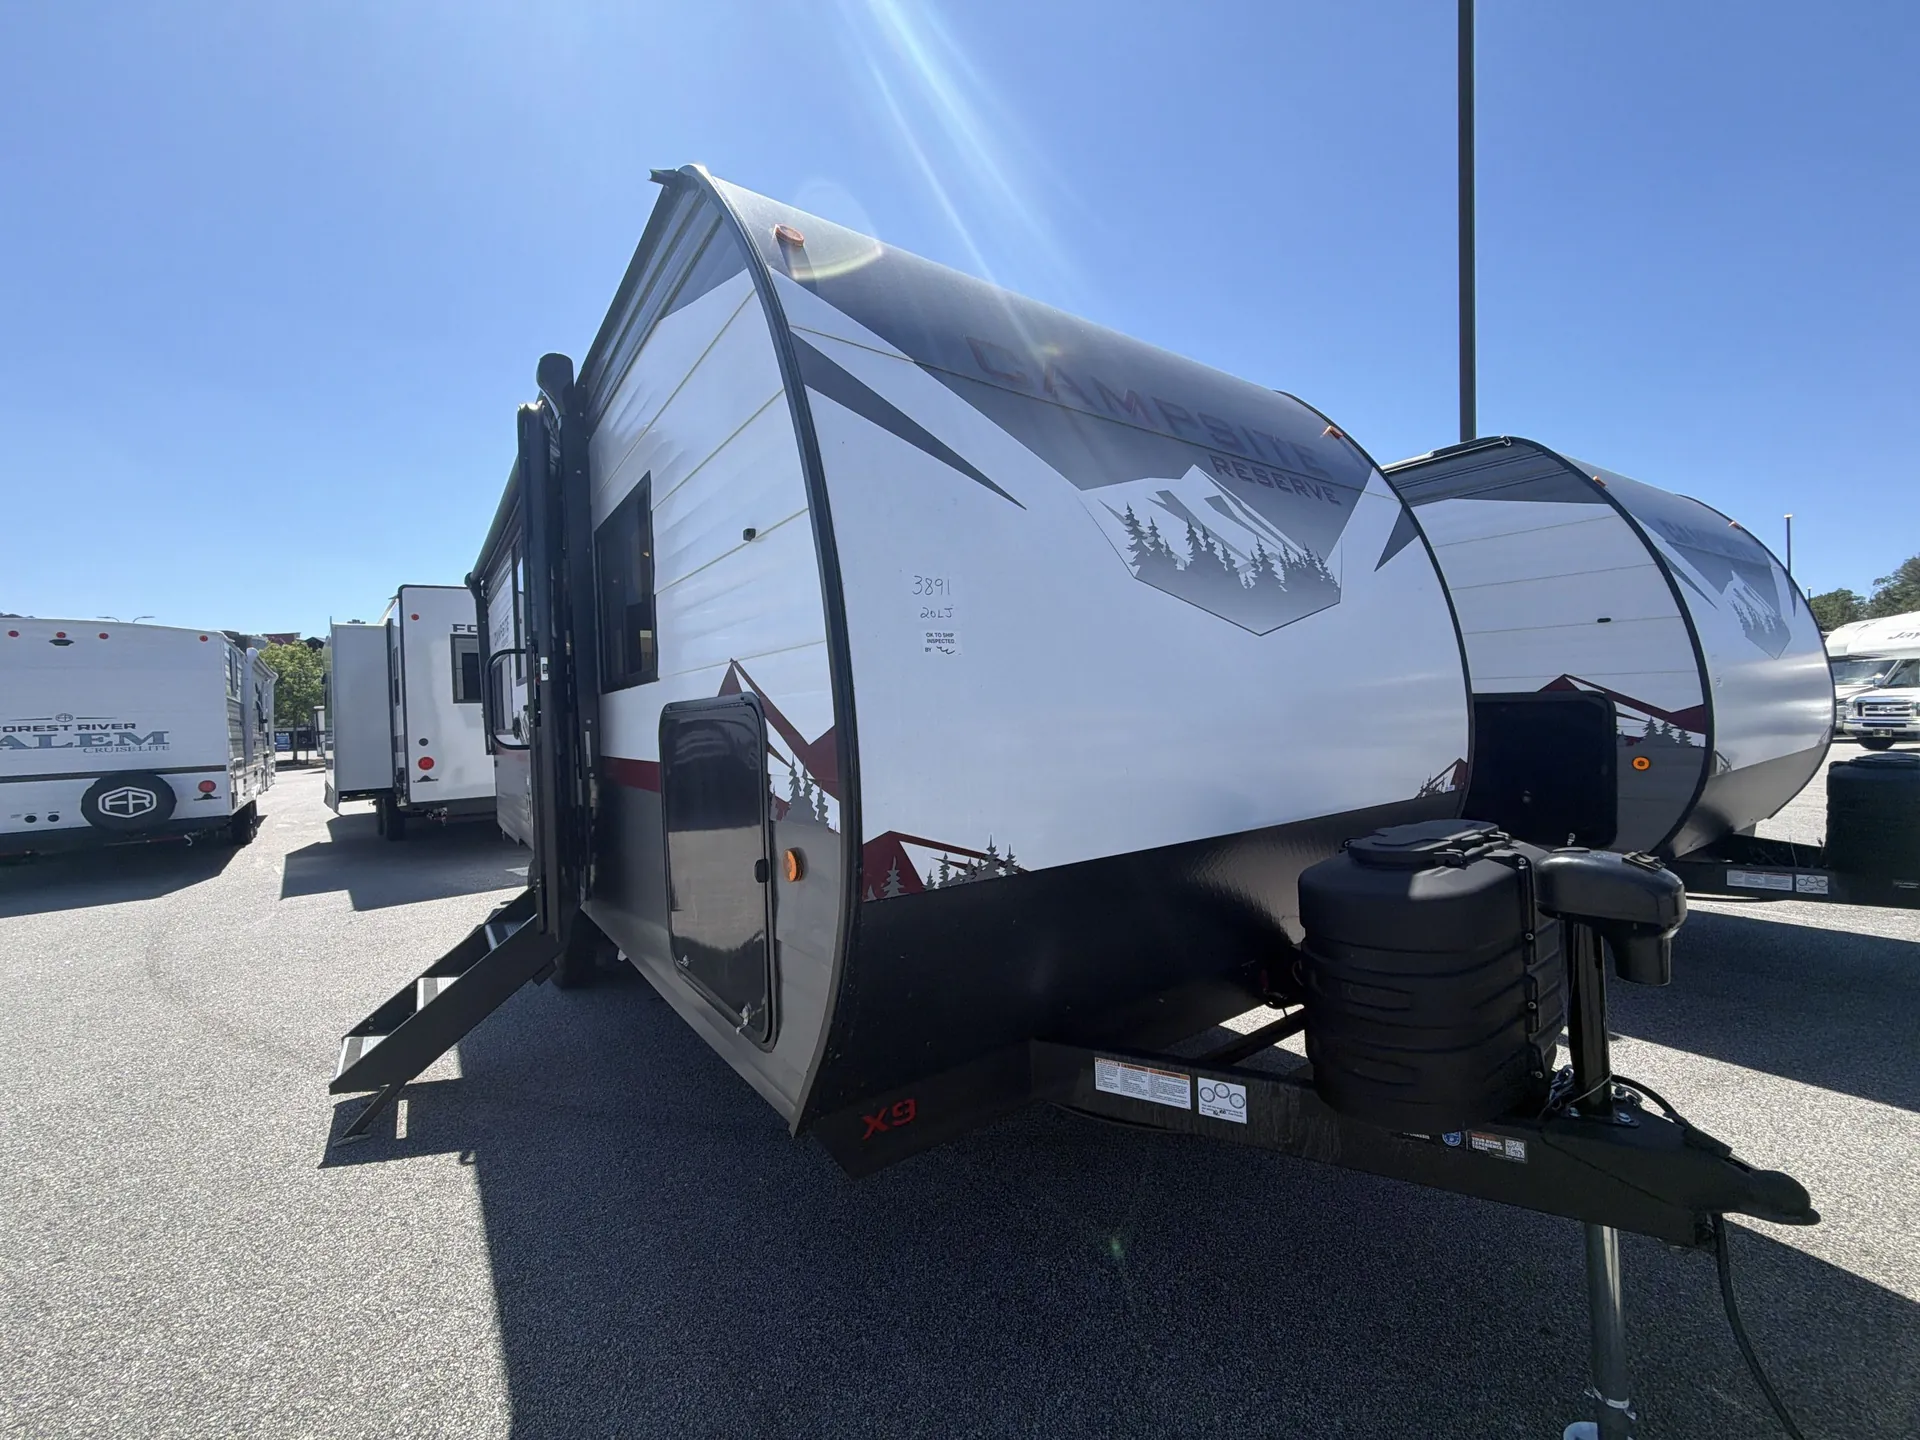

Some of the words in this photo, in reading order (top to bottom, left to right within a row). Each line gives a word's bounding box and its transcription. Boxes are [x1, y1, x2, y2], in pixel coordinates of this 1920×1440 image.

[966, 336, 1333, 480] CAMPSITE
[1209, 454, 1343, 506] RESERVE
[912, 575, 950, 596] 3891
[0, 724, 72, 733] OREST
[77, 723, 136, 731] RIVER
[863, 1098, 916, 1140] X9
